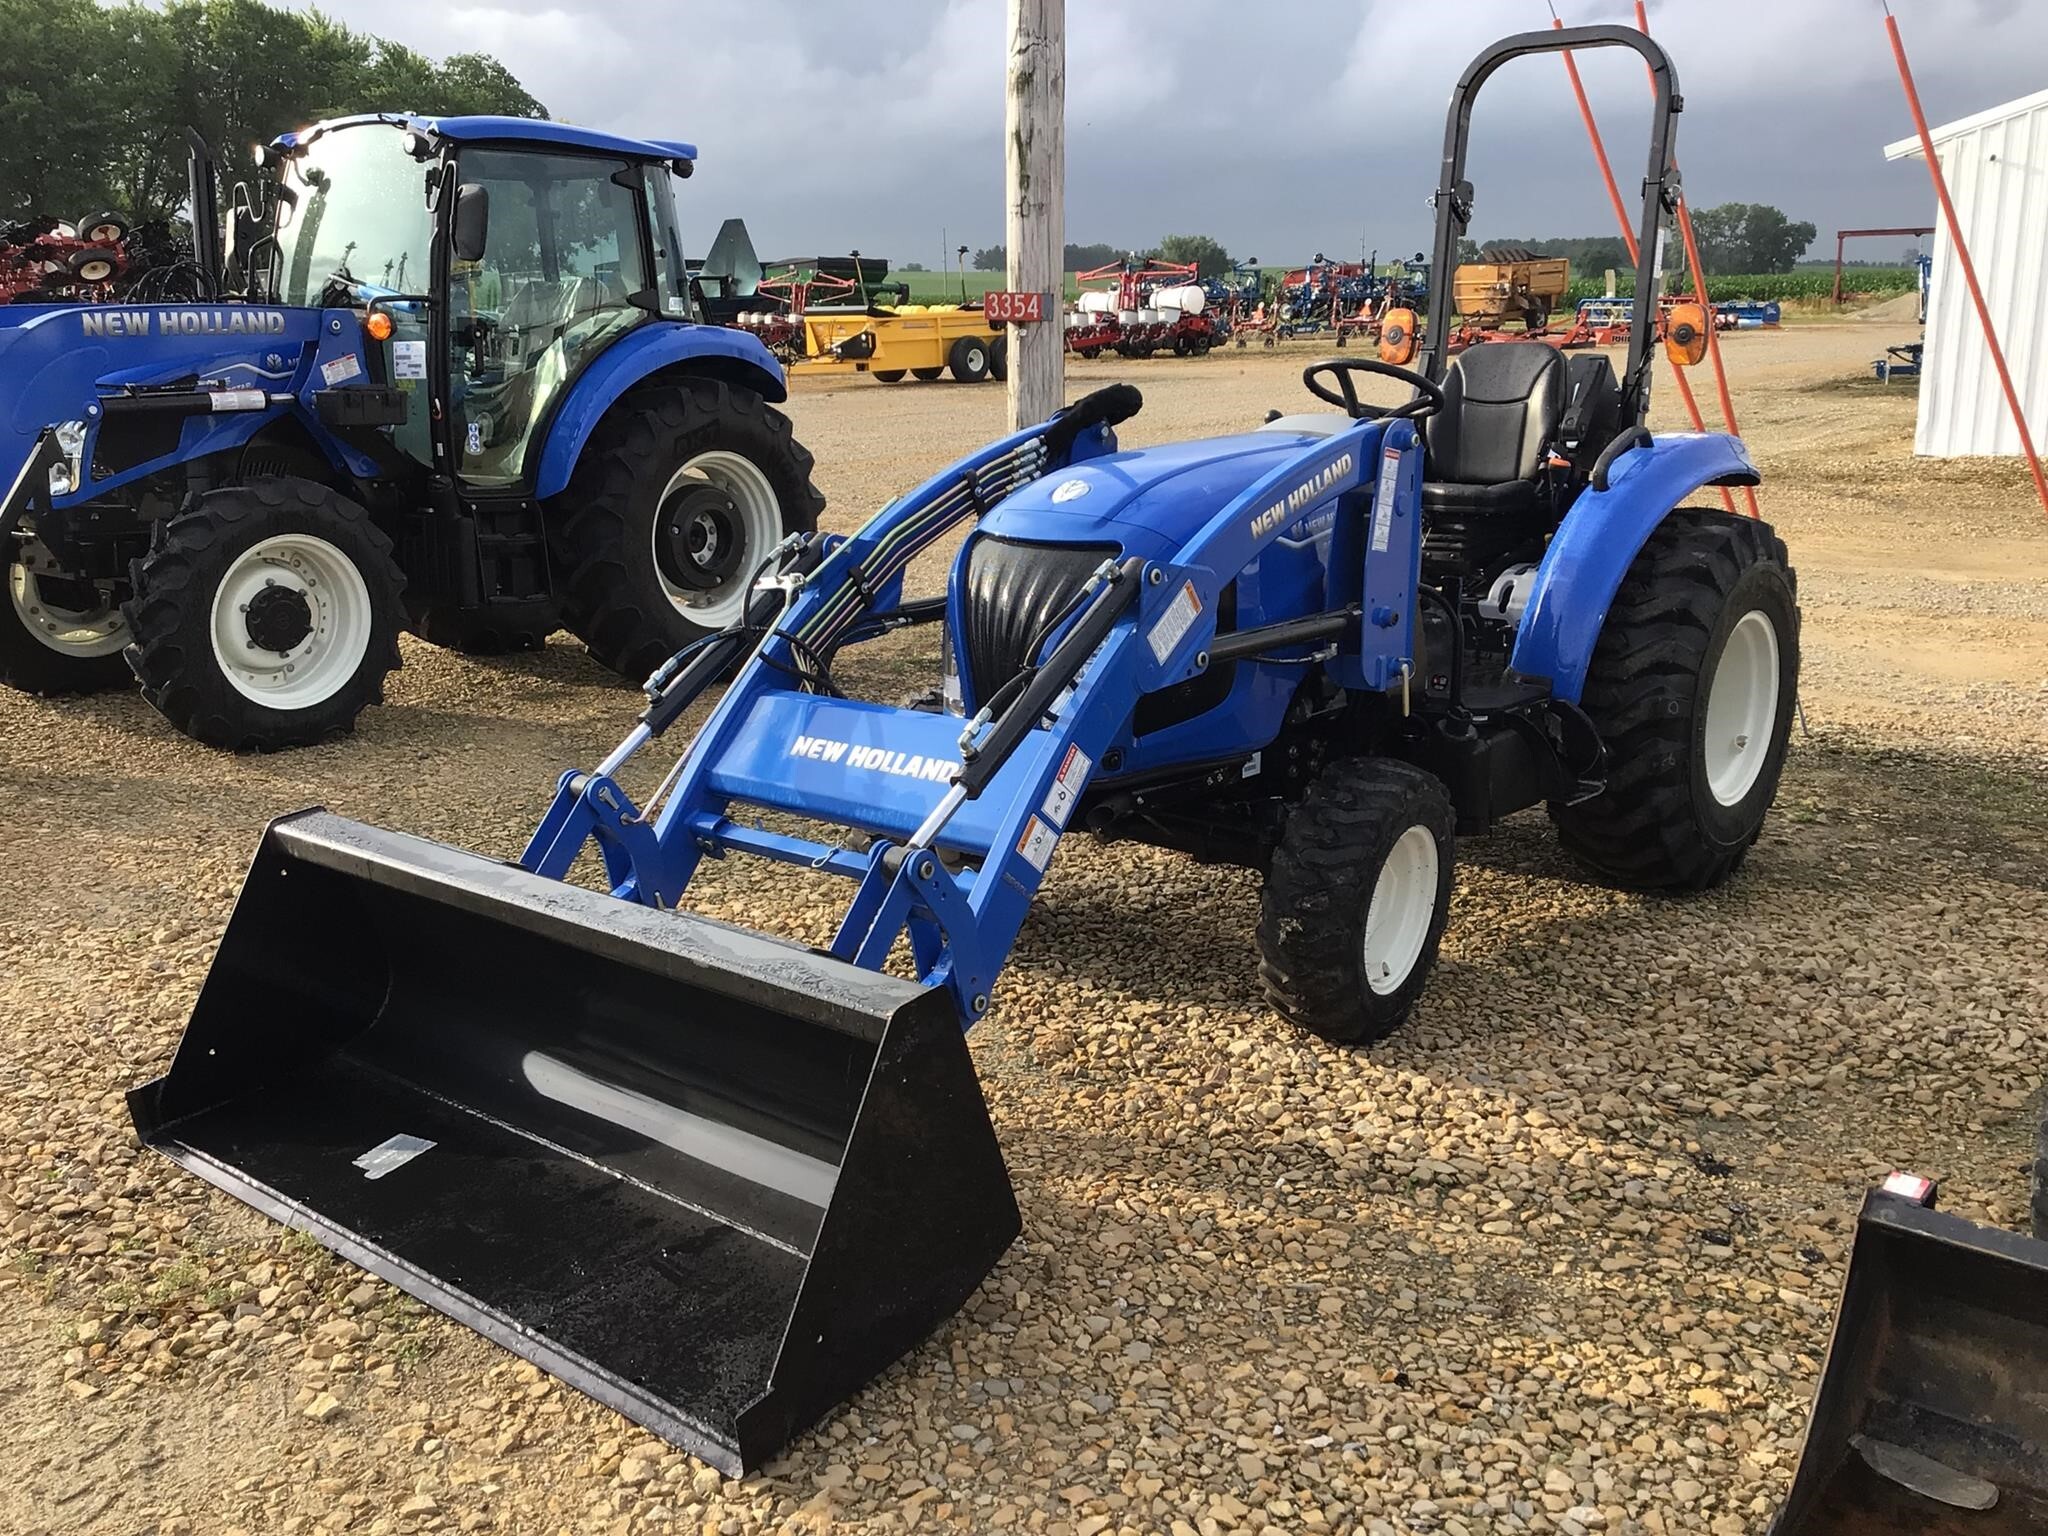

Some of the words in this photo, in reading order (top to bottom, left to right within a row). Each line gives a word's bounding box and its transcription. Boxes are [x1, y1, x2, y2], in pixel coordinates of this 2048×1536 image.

[81, 312, 150, 337] NEW
[159, 311, 286, 336] HOLLAND
[988, 293, 1039, 318] 3354
[1250, 499, 1286, 540] NEW
[1288, 453, 1352, 513] HOLLAND
[790, 735, 850, 763] NEW
[846, 745, 961, 784] HOLLAND
